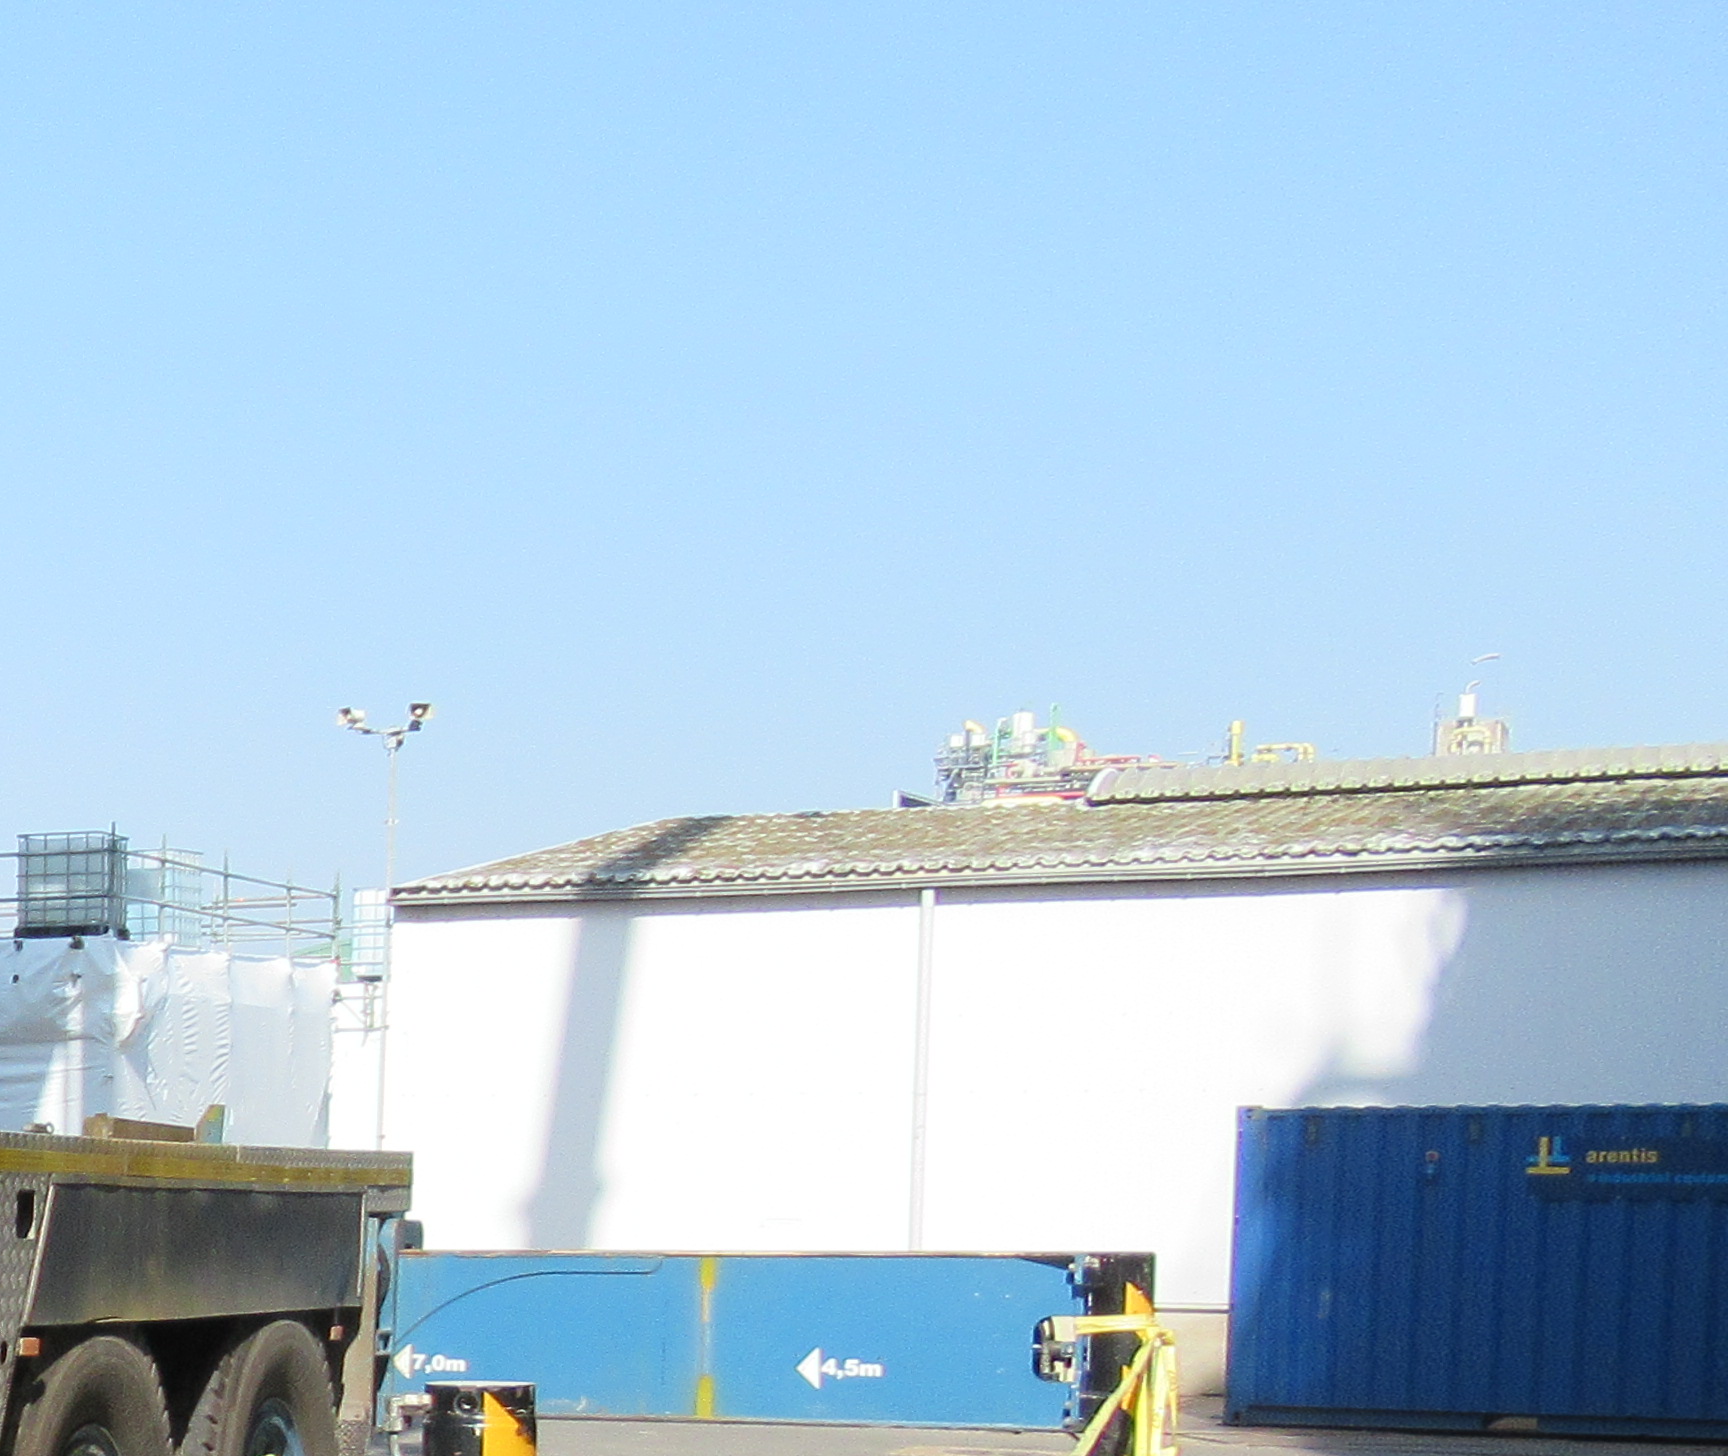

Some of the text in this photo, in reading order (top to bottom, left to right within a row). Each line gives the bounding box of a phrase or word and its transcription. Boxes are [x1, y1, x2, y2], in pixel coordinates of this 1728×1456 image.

[1585, 1147, 1660, 1164] arentis
[411, 1352, 467, 1374] 7,0m
[821, 1358, 883, 1381] 4,5m
